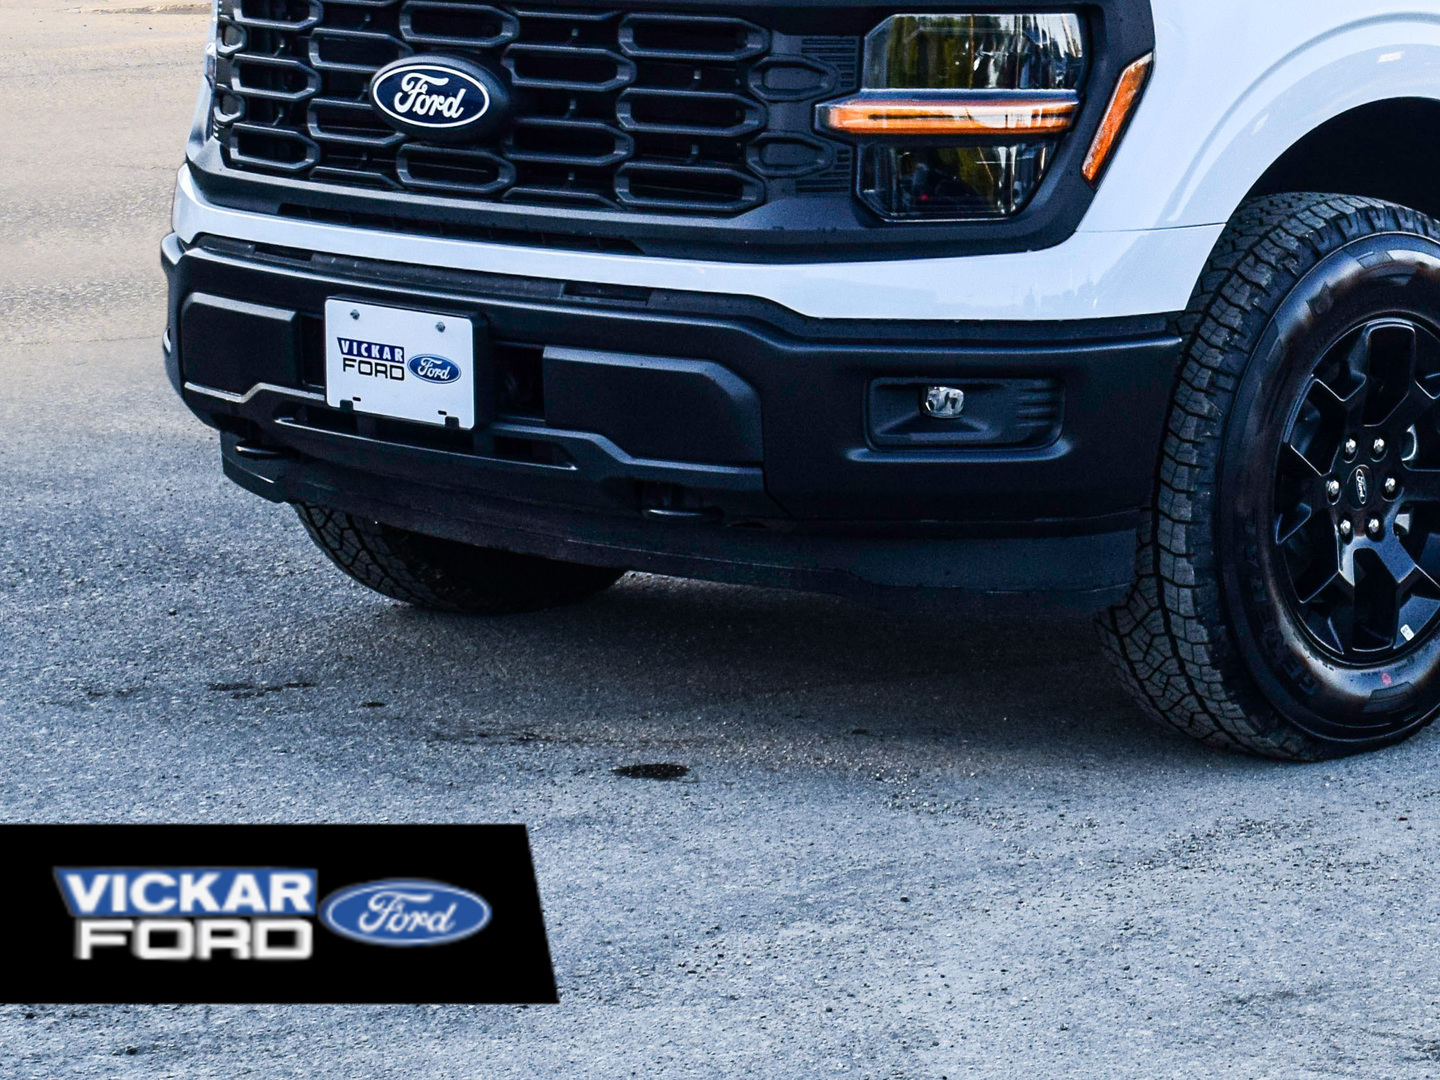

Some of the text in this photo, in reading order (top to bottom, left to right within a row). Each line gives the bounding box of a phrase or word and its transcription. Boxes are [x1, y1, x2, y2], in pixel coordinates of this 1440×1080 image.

[394, 72, 467, 119] Ford
[340, 339, 404, 363] VICKAR
[343, 357, 405, 381] FORD
[417, 357, 451, 380] Ford
